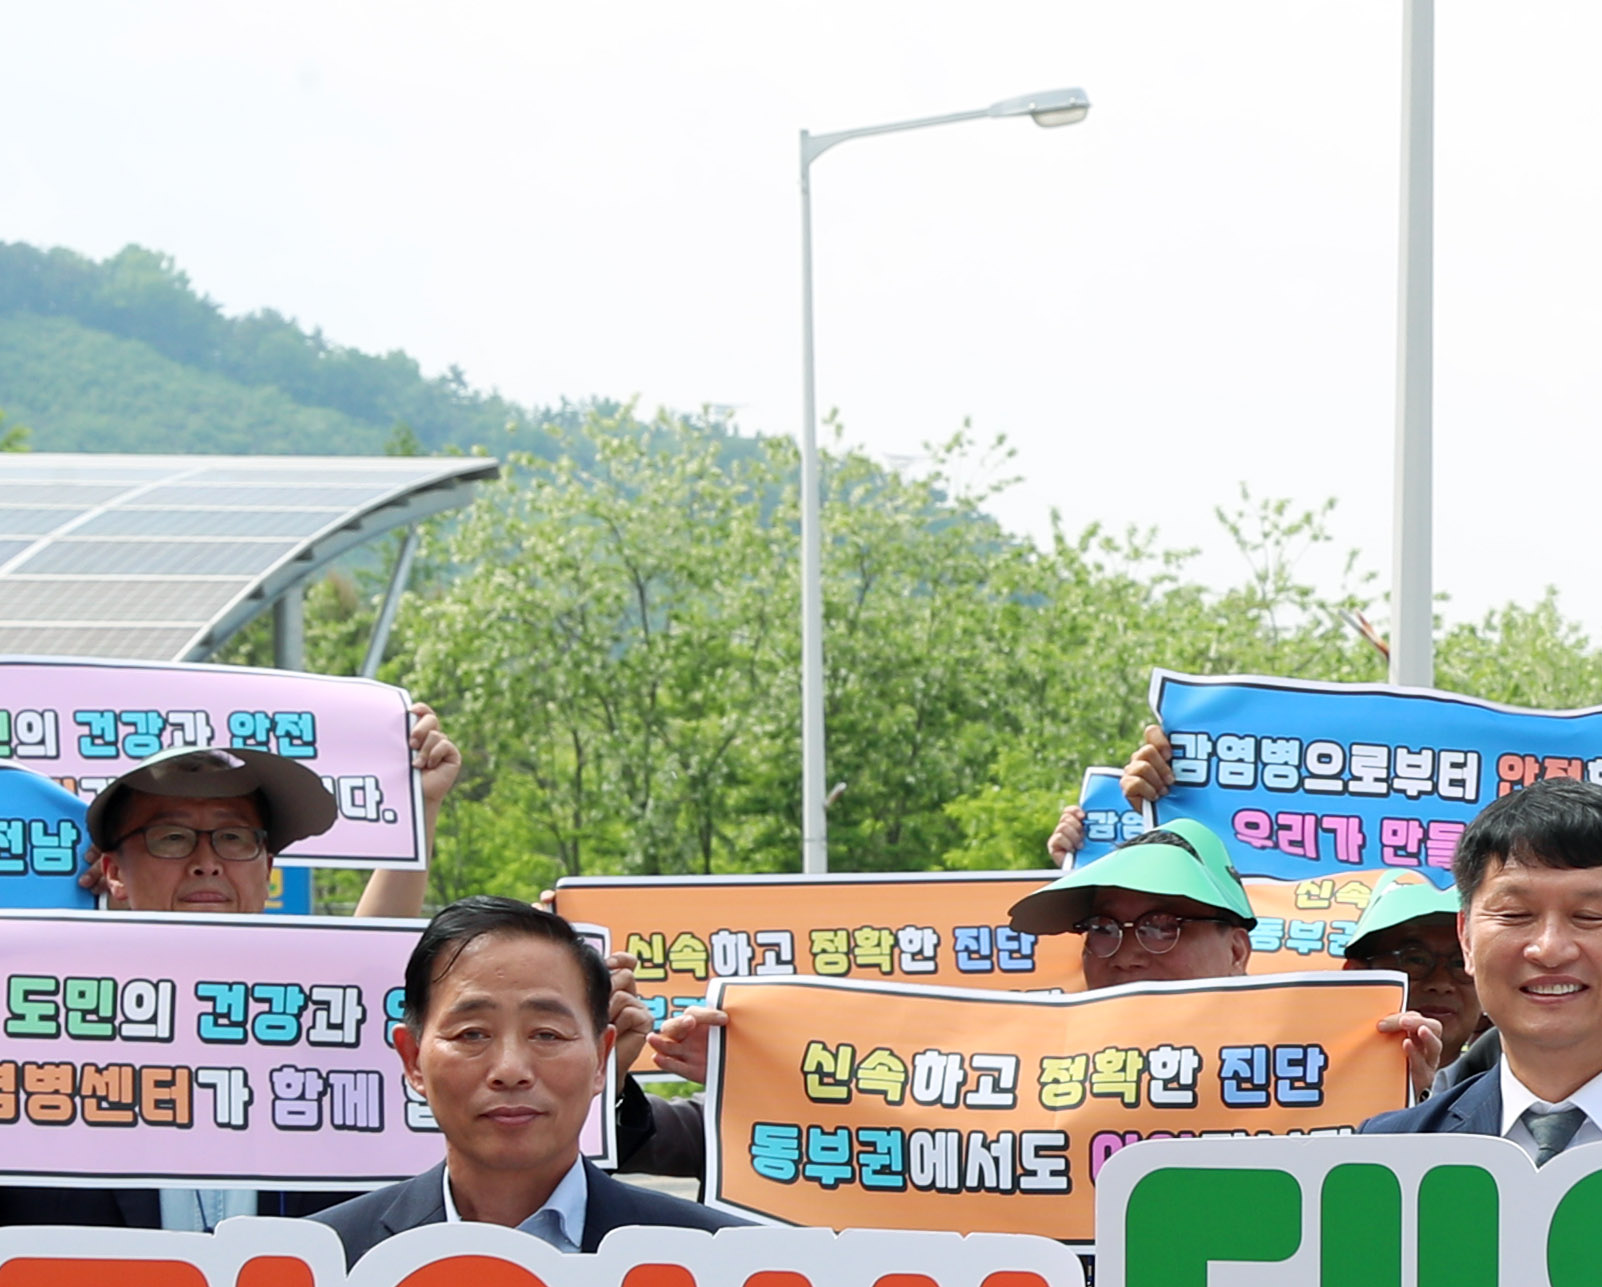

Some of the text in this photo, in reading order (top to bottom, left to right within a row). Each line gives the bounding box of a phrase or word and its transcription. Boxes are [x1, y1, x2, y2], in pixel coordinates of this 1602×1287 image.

[0, 709, 59, 759] 의
[228, 710, 316, 759] 안전
[1168, 732, 1482, 803] 감염병으로부터
[322, 776, 398, 823] 다.
[1232, 808, 1366, 865] 우리가
[1295, 880, 1392, 910] 신속
[625, 925, 1038, 981] 신속하고 정확한 진단
[4, 974, 176, 1043] 도민의
[195, 981, 368, 1048] 건강과
[269, 1065, 385, 1133] 함께
[800, 1041, 1329, 1110] 신속하고 정확한 진단
[749, 1121, 1073, 1195] 동부권에서도
